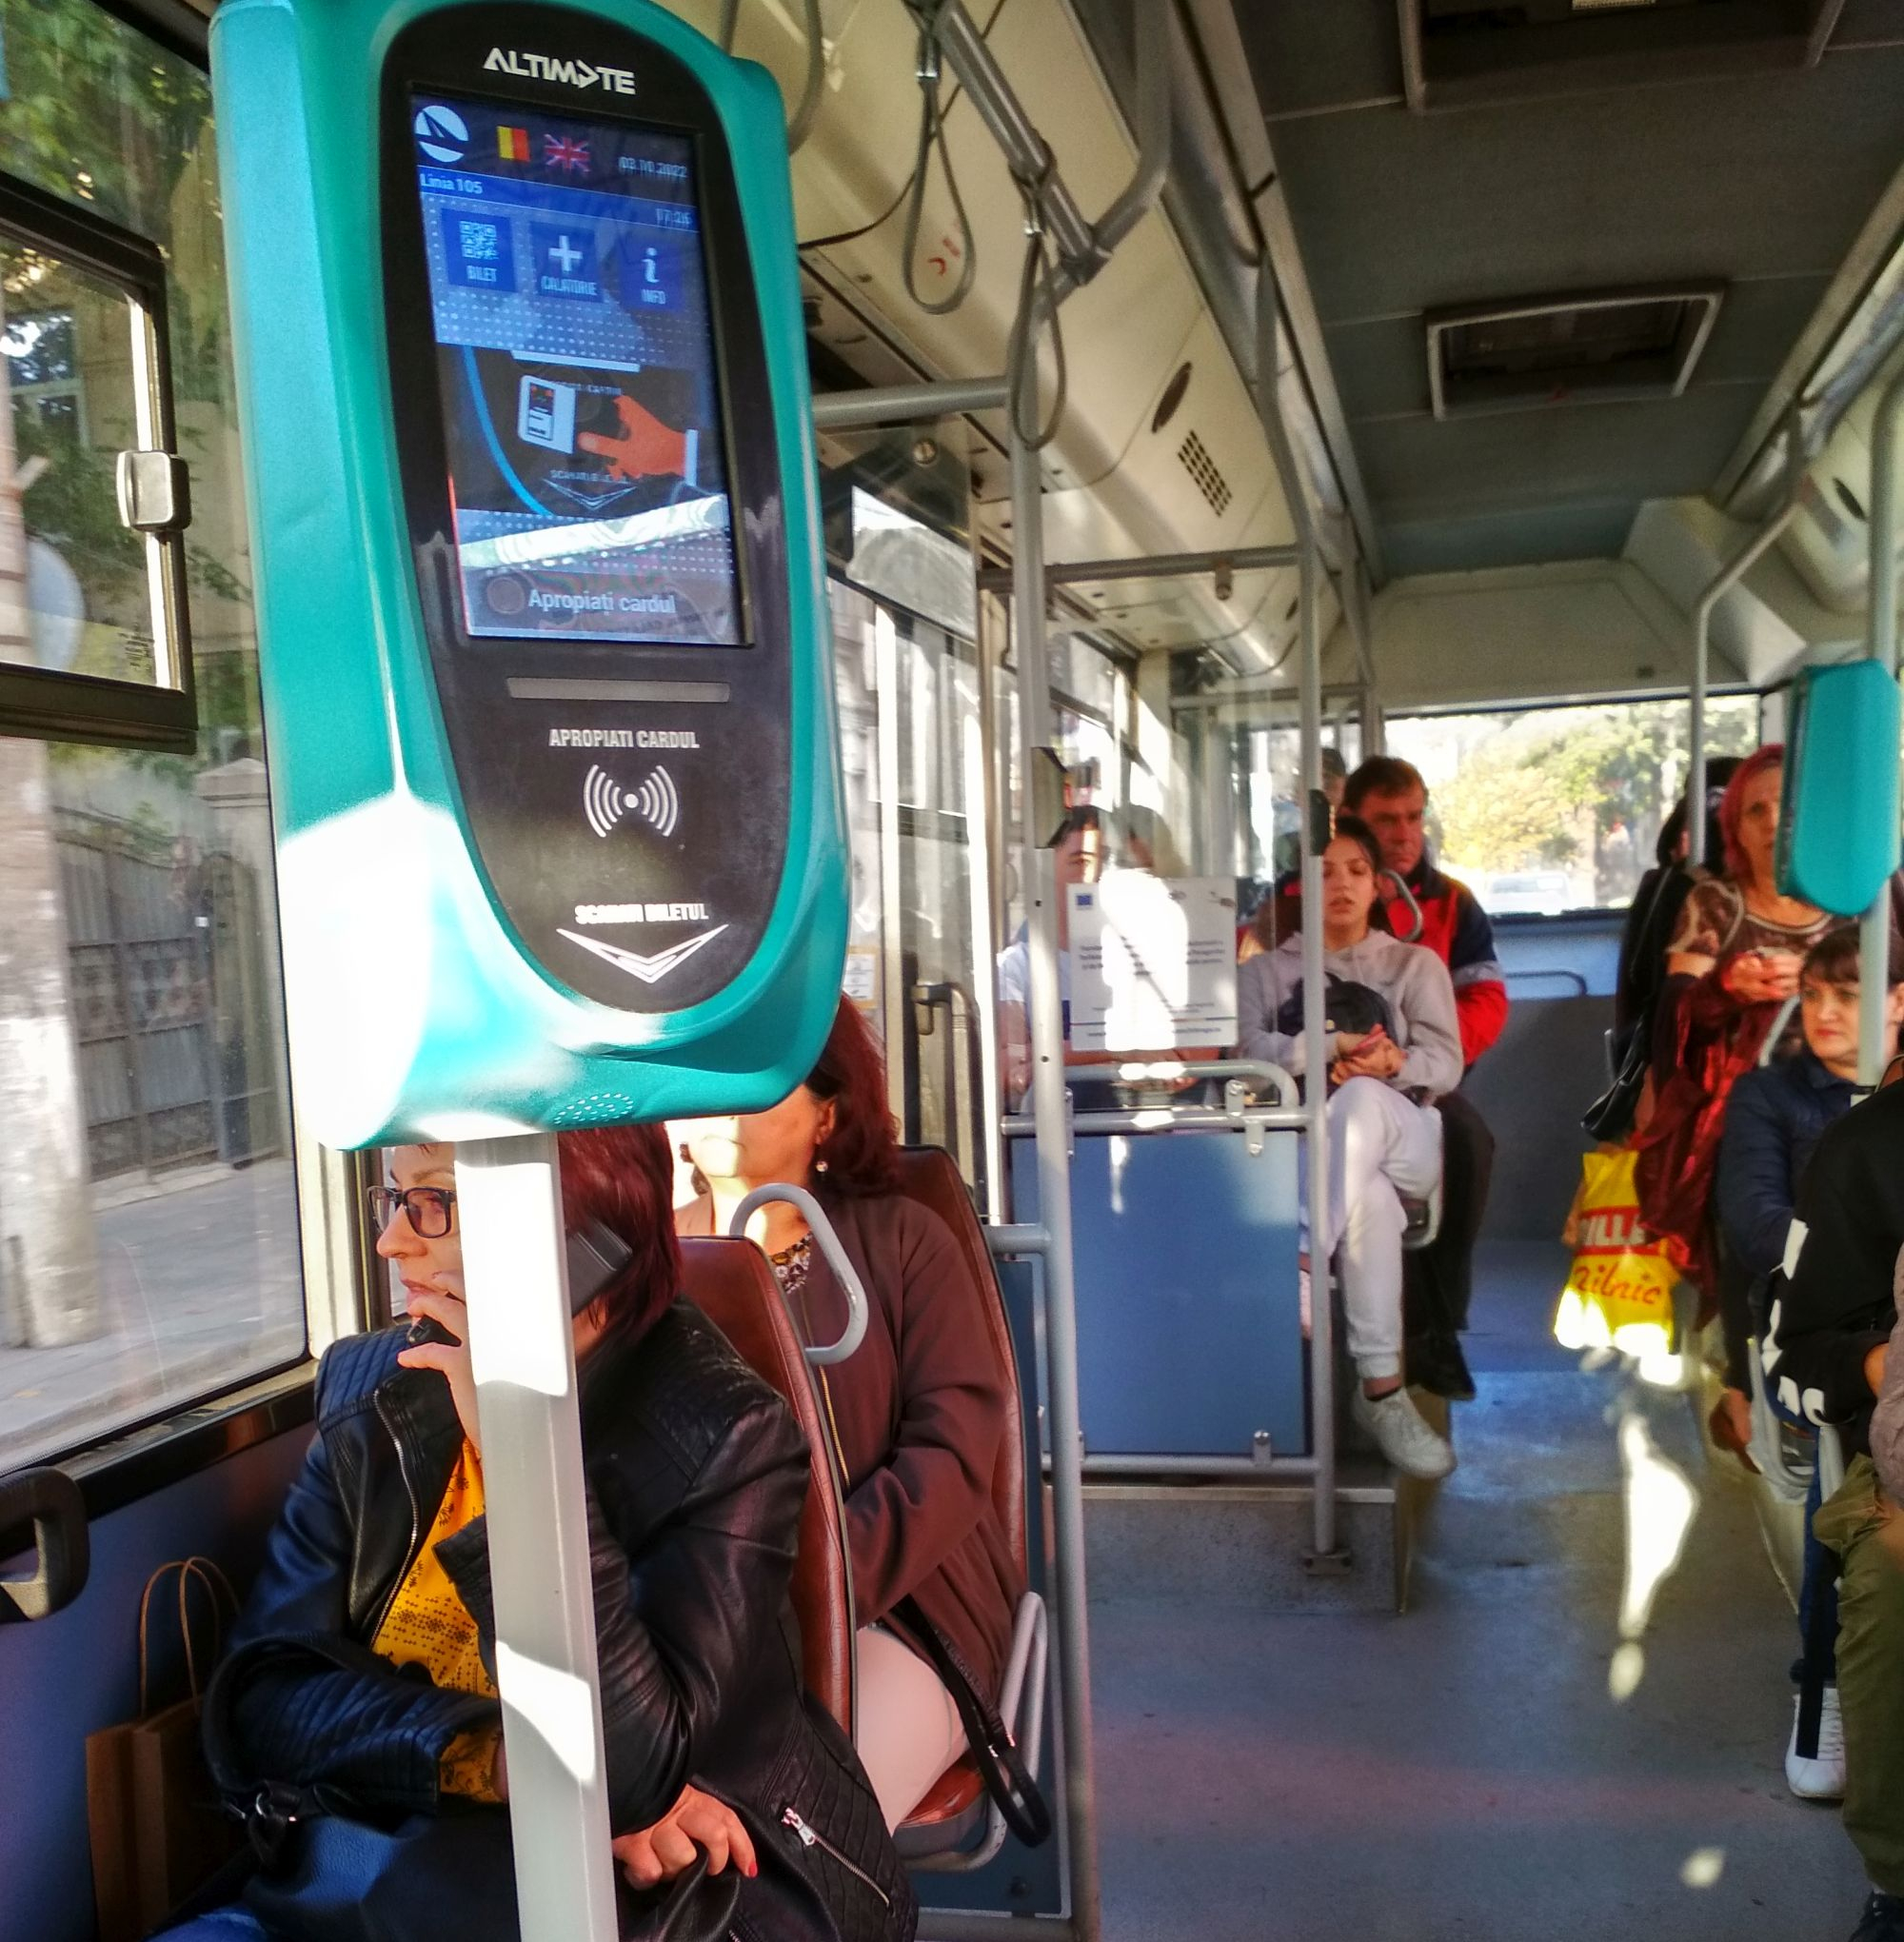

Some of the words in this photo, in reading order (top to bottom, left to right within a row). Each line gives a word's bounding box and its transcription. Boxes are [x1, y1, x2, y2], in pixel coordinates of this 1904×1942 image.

[420, 173, 455, 190] Linia
[456, 178, 484, 194] 105
[466, 265, 497, 283] BILET
[640, 288, 666, 305] INFO
[619, 593, 677, 615] cardul
[548, 728, 633, 748] APROPIATI
[635, 730, 701, 749] CARDUL
